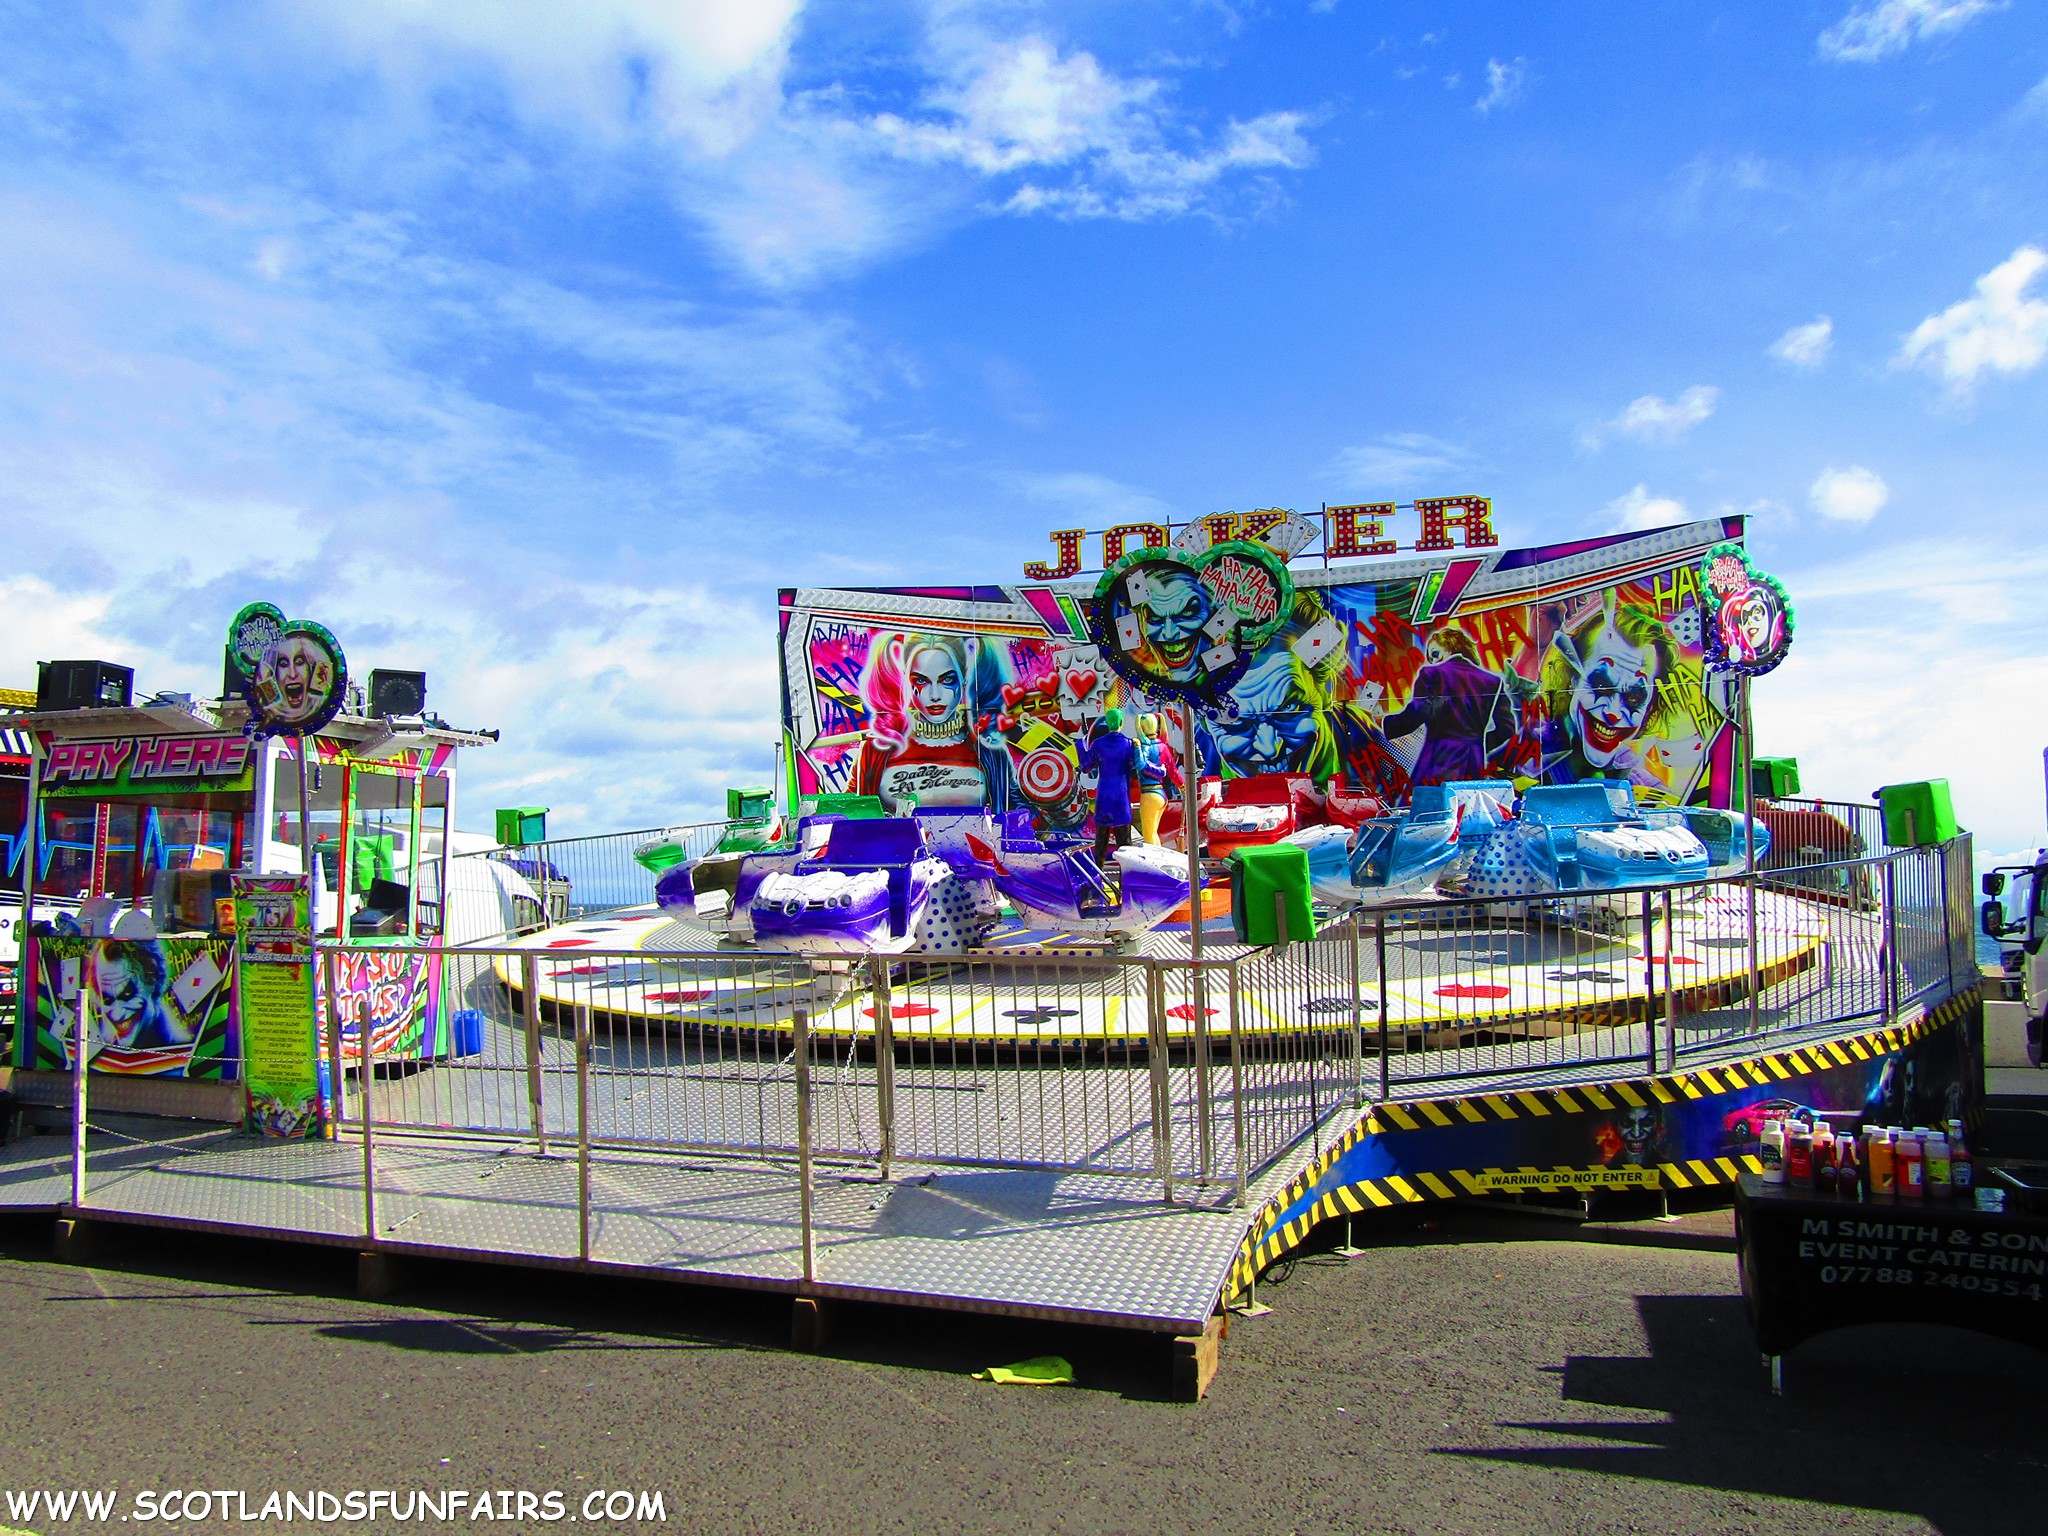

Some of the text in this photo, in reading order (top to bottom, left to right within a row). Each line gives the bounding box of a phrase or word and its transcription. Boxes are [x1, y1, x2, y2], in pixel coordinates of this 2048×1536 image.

[1024, 495, 1498, 580] JOKER
[1198, 564, 1222, 588] HA
[1223, 556, 1243, 581] HA
[1240, 566, 1269, 602] HA
[1215, 577, 1239, 605] HA
[1252, 594, 1277, 622] HA
[1653, 565, 1700, 618] HA
[1354, 609, 1420, 651] HA
[815, 655, 864, 698] HA
[1012, 645, 1043, 679] HA
[1655, 664, 1701, 716] HA
[43, 735, 250, 782] PAY HERE
[1349, 743, 1401, 790] HA
[1501, 734, 1541, 770] HA
[893, 765, 954, 785] Daddy's
[919, 776, 983, 790] Monster
[1491, 1172, 1642, 1185] WARNING DO NOT ENTER
[1802, 1218, 1829, 1235] M
[1837, 1220, 1939, 1243] SMITH
[1947, 1229, 1972, 1245] &
[1799, 1241, 2048, 1276] EVENT CATERIN
[1820, 1265, 2043, 1301] 07788 240554
